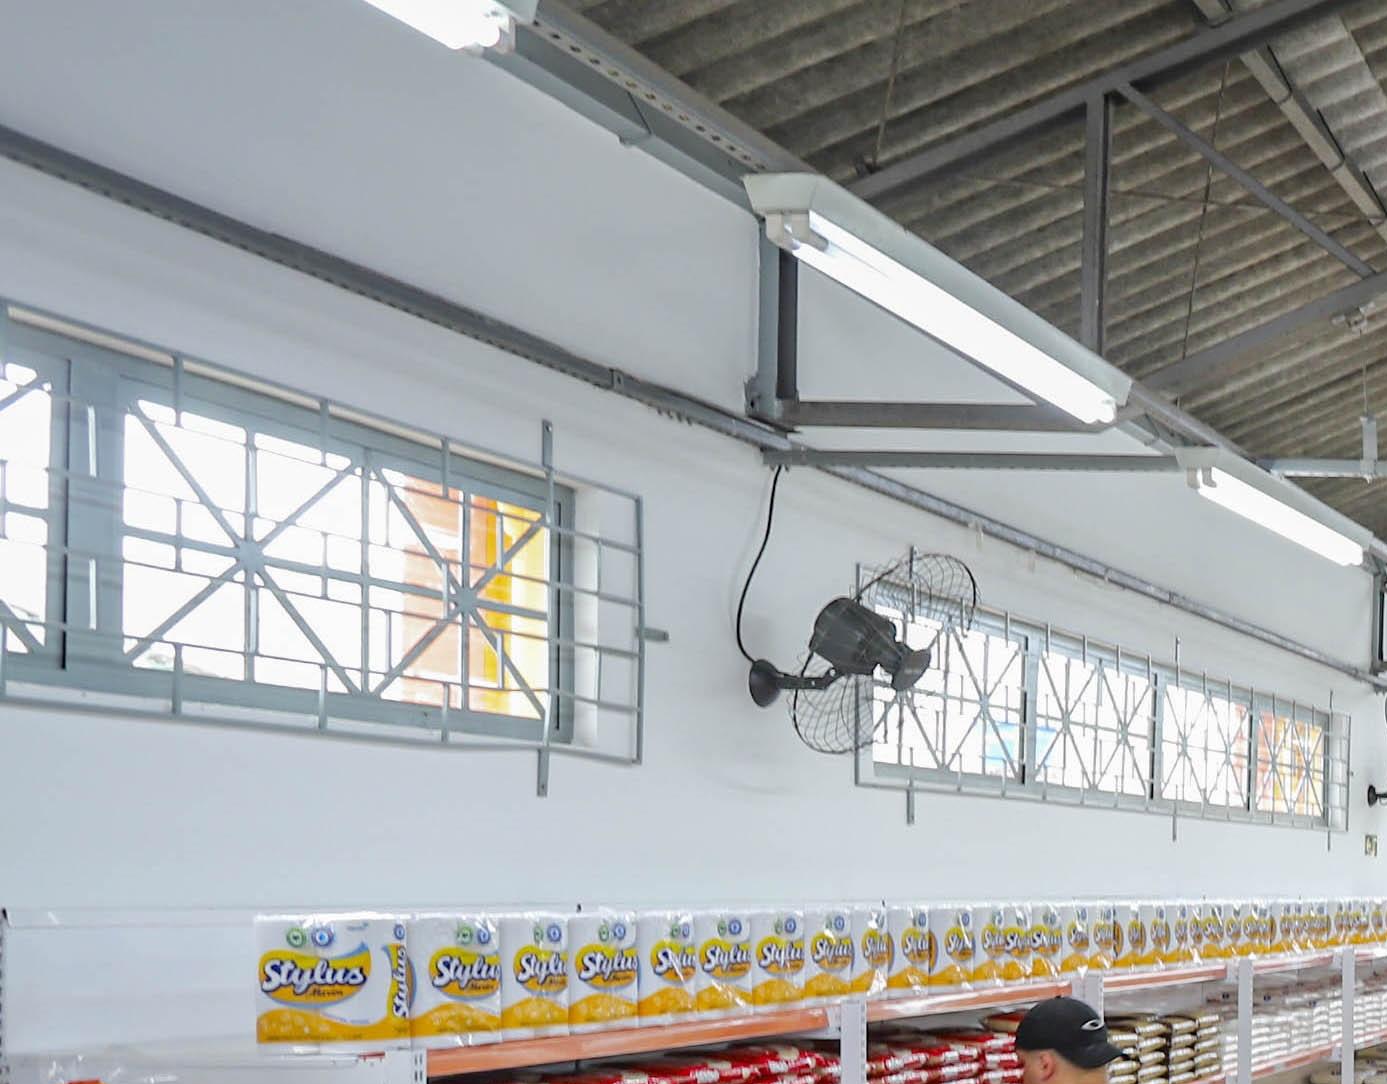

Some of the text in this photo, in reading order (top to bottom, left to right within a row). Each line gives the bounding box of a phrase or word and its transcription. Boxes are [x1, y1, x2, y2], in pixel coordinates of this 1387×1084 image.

[260, 958, 368, 995] Stylus
[431, 953, 500, 990] Stylu
[702, 946, 750, 972] Stylu
